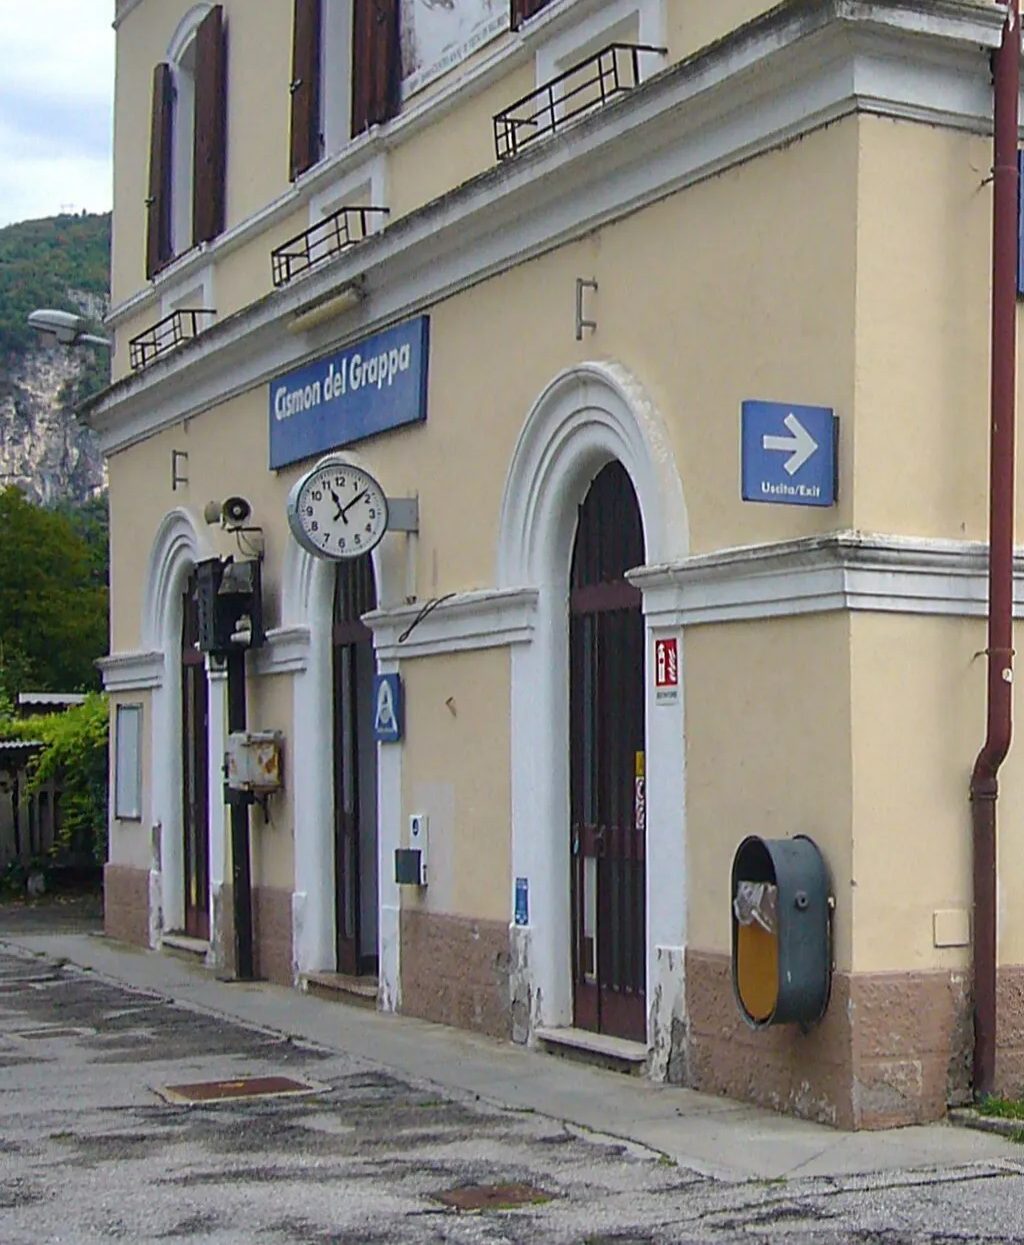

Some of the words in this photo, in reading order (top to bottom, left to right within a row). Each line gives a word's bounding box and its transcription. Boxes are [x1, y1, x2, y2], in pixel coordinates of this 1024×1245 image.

[275, 380, 320, 421] Cismon
[323, 357, 347, 401] del
[350, 343, 410, 391] Grappa
[322, 480, 331, 490] 11
[335, 476, 345, 487] 12
[353, 481, 358, 491] 1
[761, 481, 821, 497] Uscita/Exit
[311, 491, 322, 501] 10
[364, 494, 371, 504] 2
[306, 506, 313, 516] 9
[369, 509, 375, 519] 3
[311, 521, 319, 532] 8
[365, 523, 371, 532] 4
[323, 533, 330, 543] 7
[338, 538, 345, 548] 6
[354, 533, 361, 544] 5
